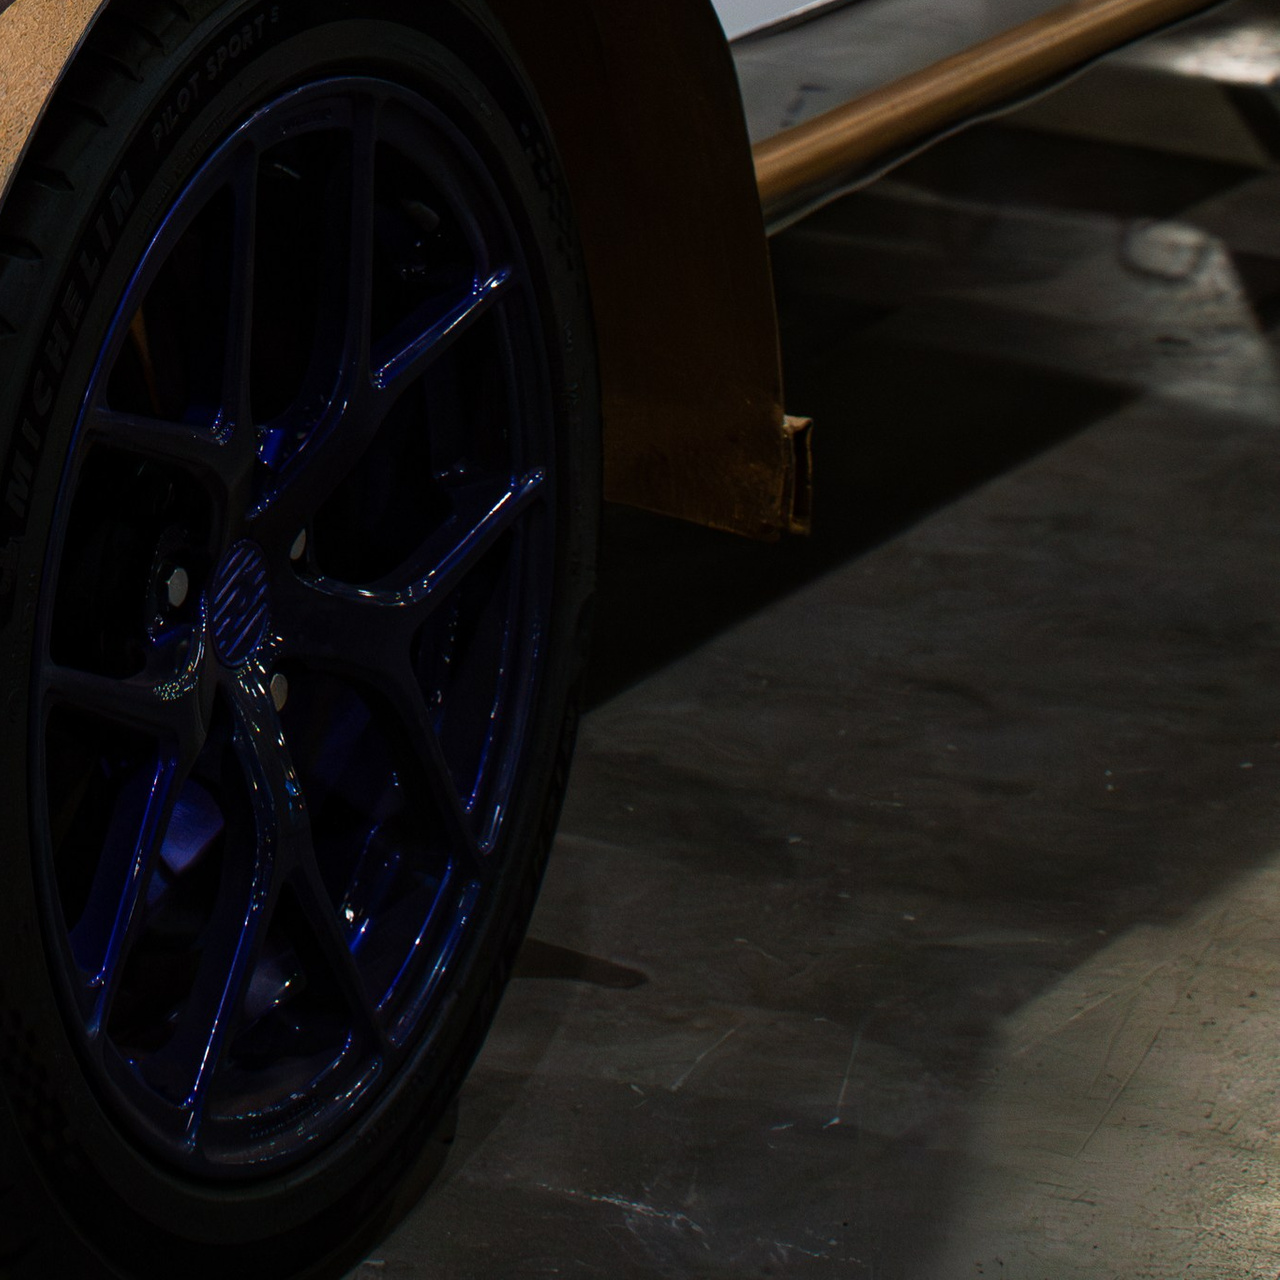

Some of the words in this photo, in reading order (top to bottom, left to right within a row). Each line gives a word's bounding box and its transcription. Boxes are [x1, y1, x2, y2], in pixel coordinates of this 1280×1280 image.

[151, 70, 200, 153] PILOT
[205, 13, 266, 81] SPORT
[4, 168, 135, 519] MICHELIN
